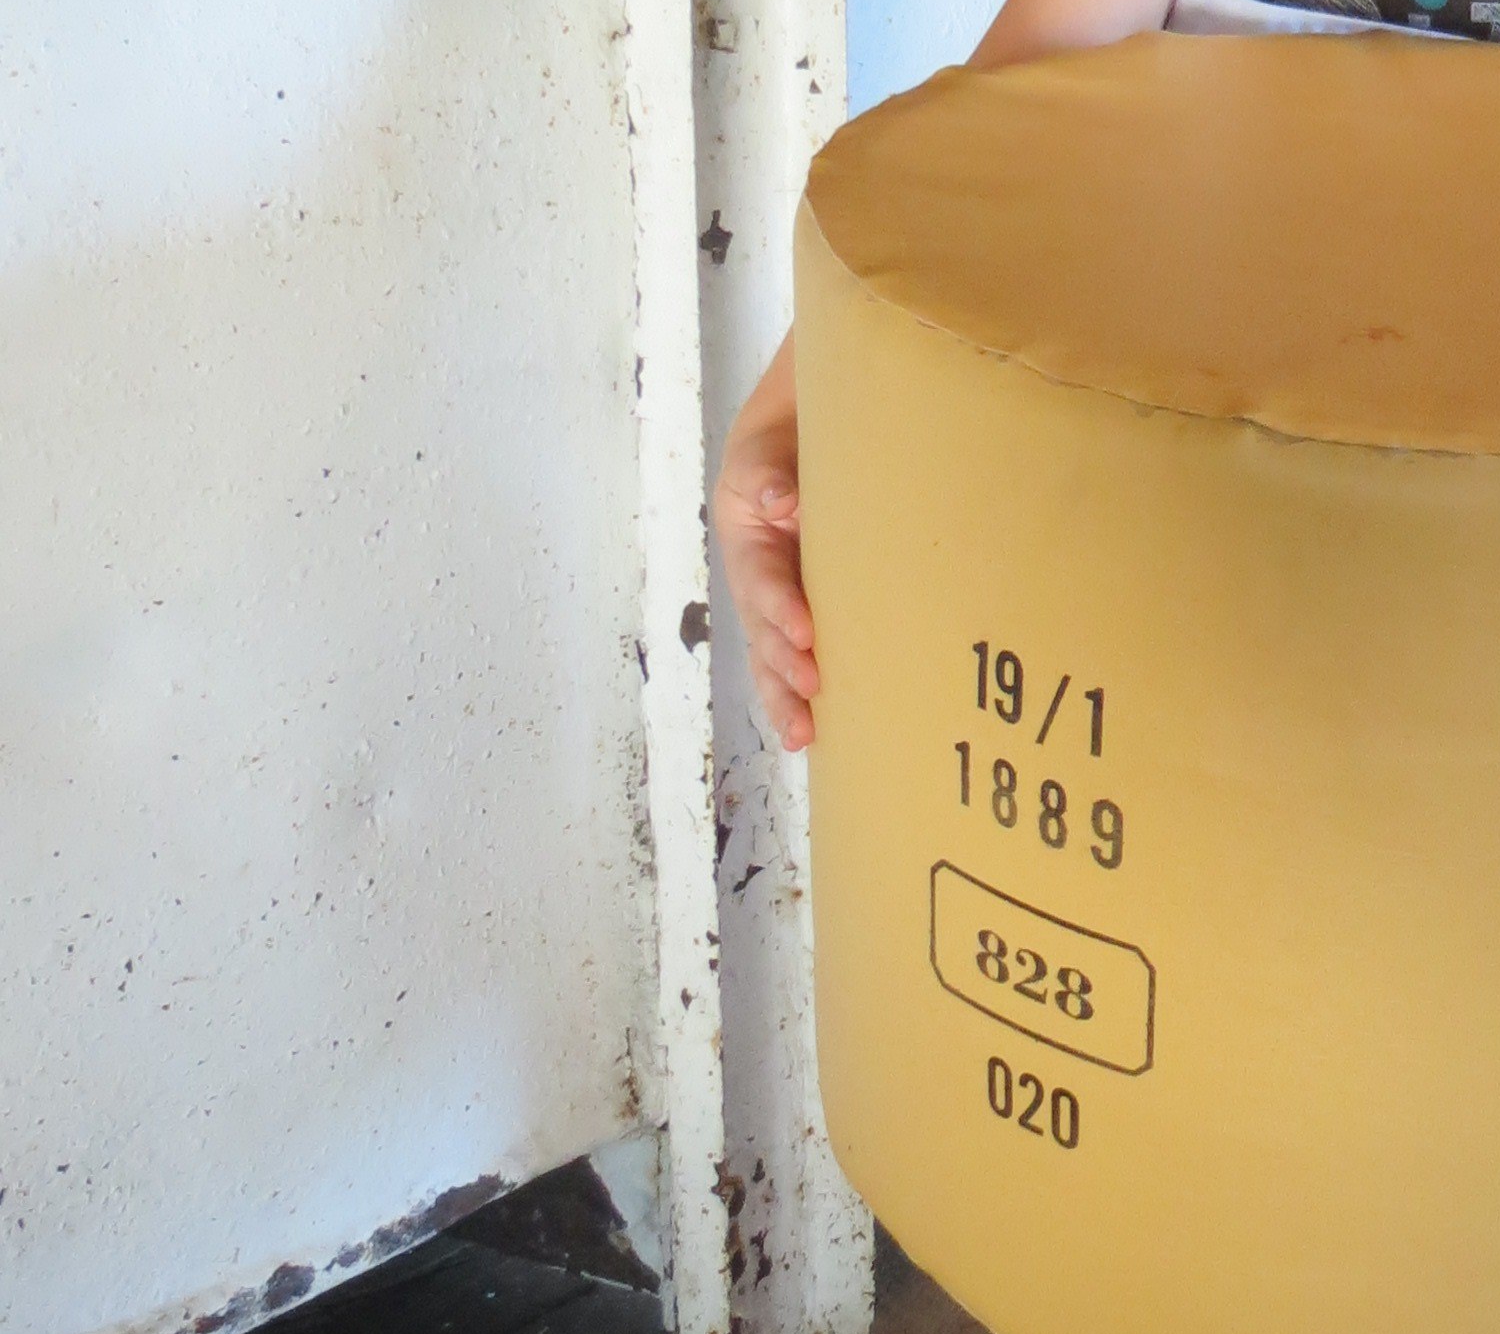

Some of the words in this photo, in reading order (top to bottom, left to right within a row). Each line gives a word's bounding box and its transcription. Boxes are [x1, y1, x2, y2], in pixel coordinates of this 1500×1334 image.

[972, 640, 1106, 758] 19/1
[954, 740, 1125, 871] 1889
[975, 928, 1095, 1022] 828
[987, 1055, 1081, 1150] 020
